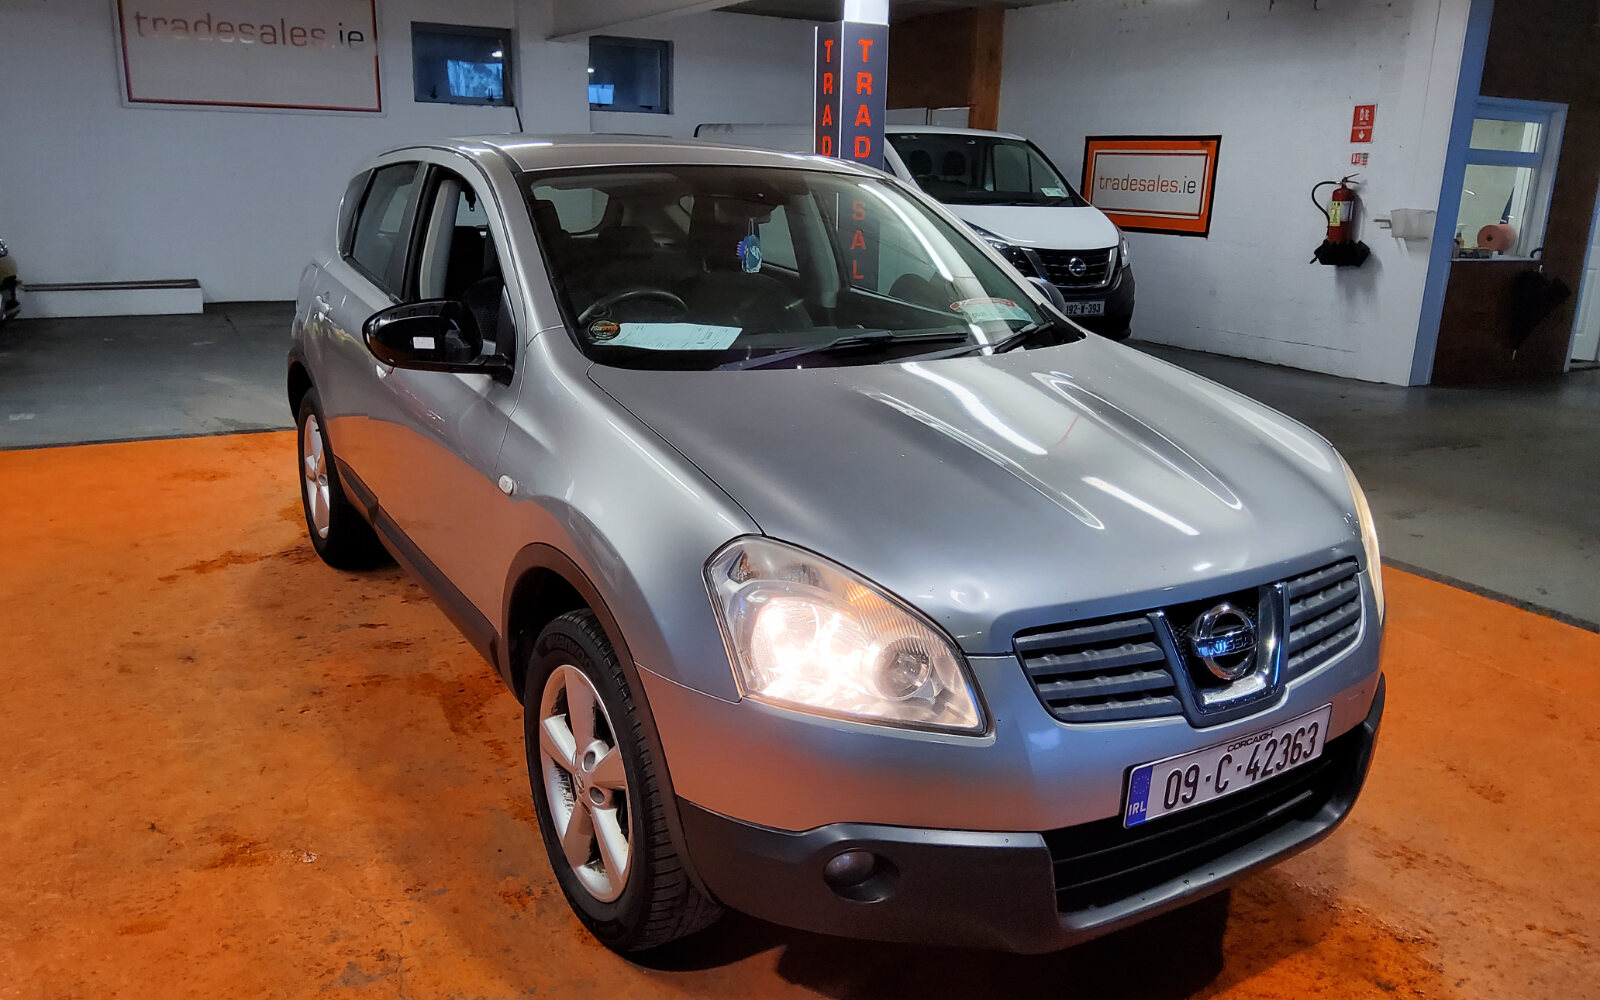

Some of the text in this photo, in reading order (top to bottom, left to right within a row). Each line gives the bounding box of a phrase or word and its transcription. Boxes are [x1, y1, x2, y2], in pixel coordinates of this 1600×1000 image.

[1099, 172, 1197, 194] tradesales.ie
[1227, 731, 1273, 752] CORCAIGH
[1128, 801, 1147, 817] IRL
